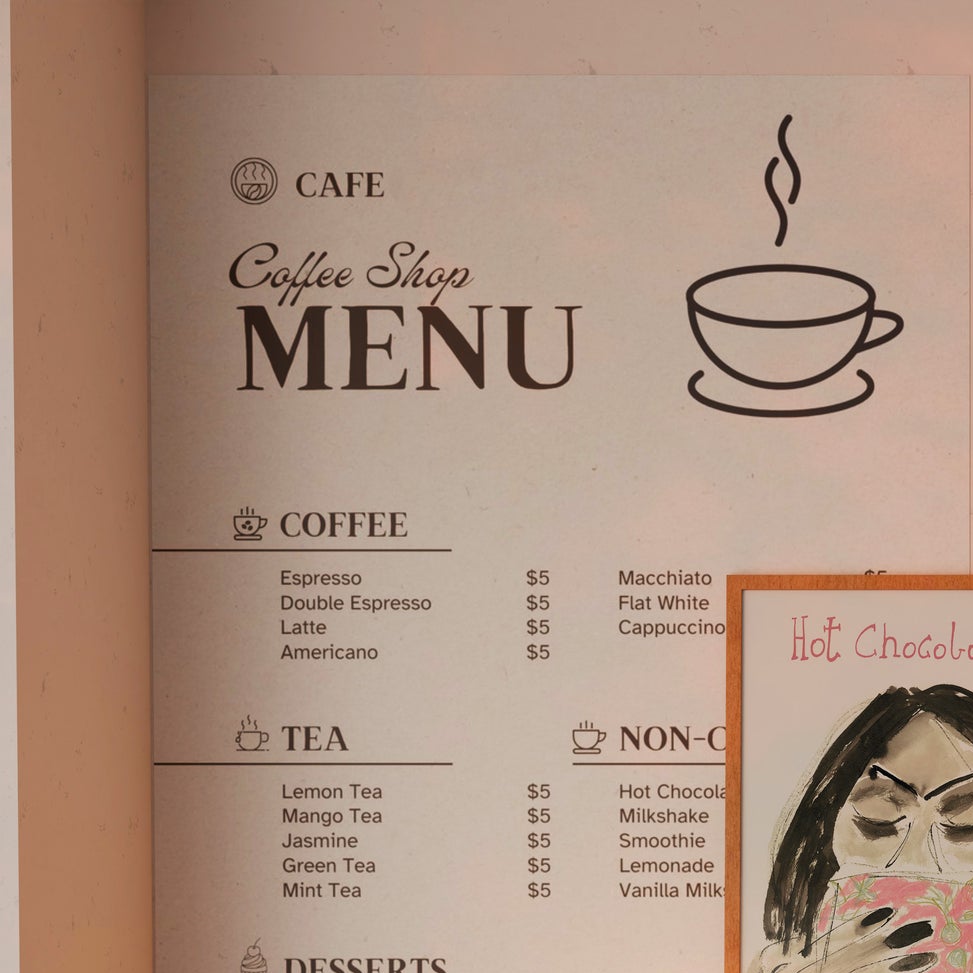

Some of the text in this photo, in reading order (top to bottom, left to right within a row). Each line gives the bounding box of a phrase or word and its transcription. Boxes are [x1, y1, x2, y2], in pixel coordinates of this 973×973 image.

[296, 172, 384, 197] CAFE
[229, 241, 475, 307] Coffee Shop
[236, 306, 582, 391] MENU
[280, 512, 407, 537] COFFEE
[281, 570, 361, 588] Espresso
[527, 569, 549, 586] $5
[619, 570, 712, 585] Macchiato
[281, 595, 431, 613] Double Espresso
[527, 595, 549, 611] $5
[619, 595, 709, 610] Flat White
[281, 619, 326, 635] Latte
[527, 619, 549, 636] $5
[619, 619, 725, 637] Cappuccino
[791, 615, 841, 662] Hot
[280, 644, 378, 660] Americano
[527, 644, 550, 660] $5
[282, 726, 348, 751] TEA
[282, 784, 382, 799] Lemon Tea
[528, 783, 550, 800] $5
[620, 784, 650, 799] Hot
[283, 808, 382, 827] Mango Tea
[528, 808, 550, 824] $5
[620, 808, 709, 823] Milkshake
[282, 832, 358, 848] Jasmine
[528, 833, 550, 849] $5
[620, 833, 705, 848] Smoothie
[283, 858, 375, 873] Green Tea
[528, 857, 550, 873] $5
[620, 858, 714, 873] Lemonade
[283, 882, 361, 897] Mint Tea
[528, 882, 551, 898] $5
[620, 882, 724, 897] Vanilla Milk
